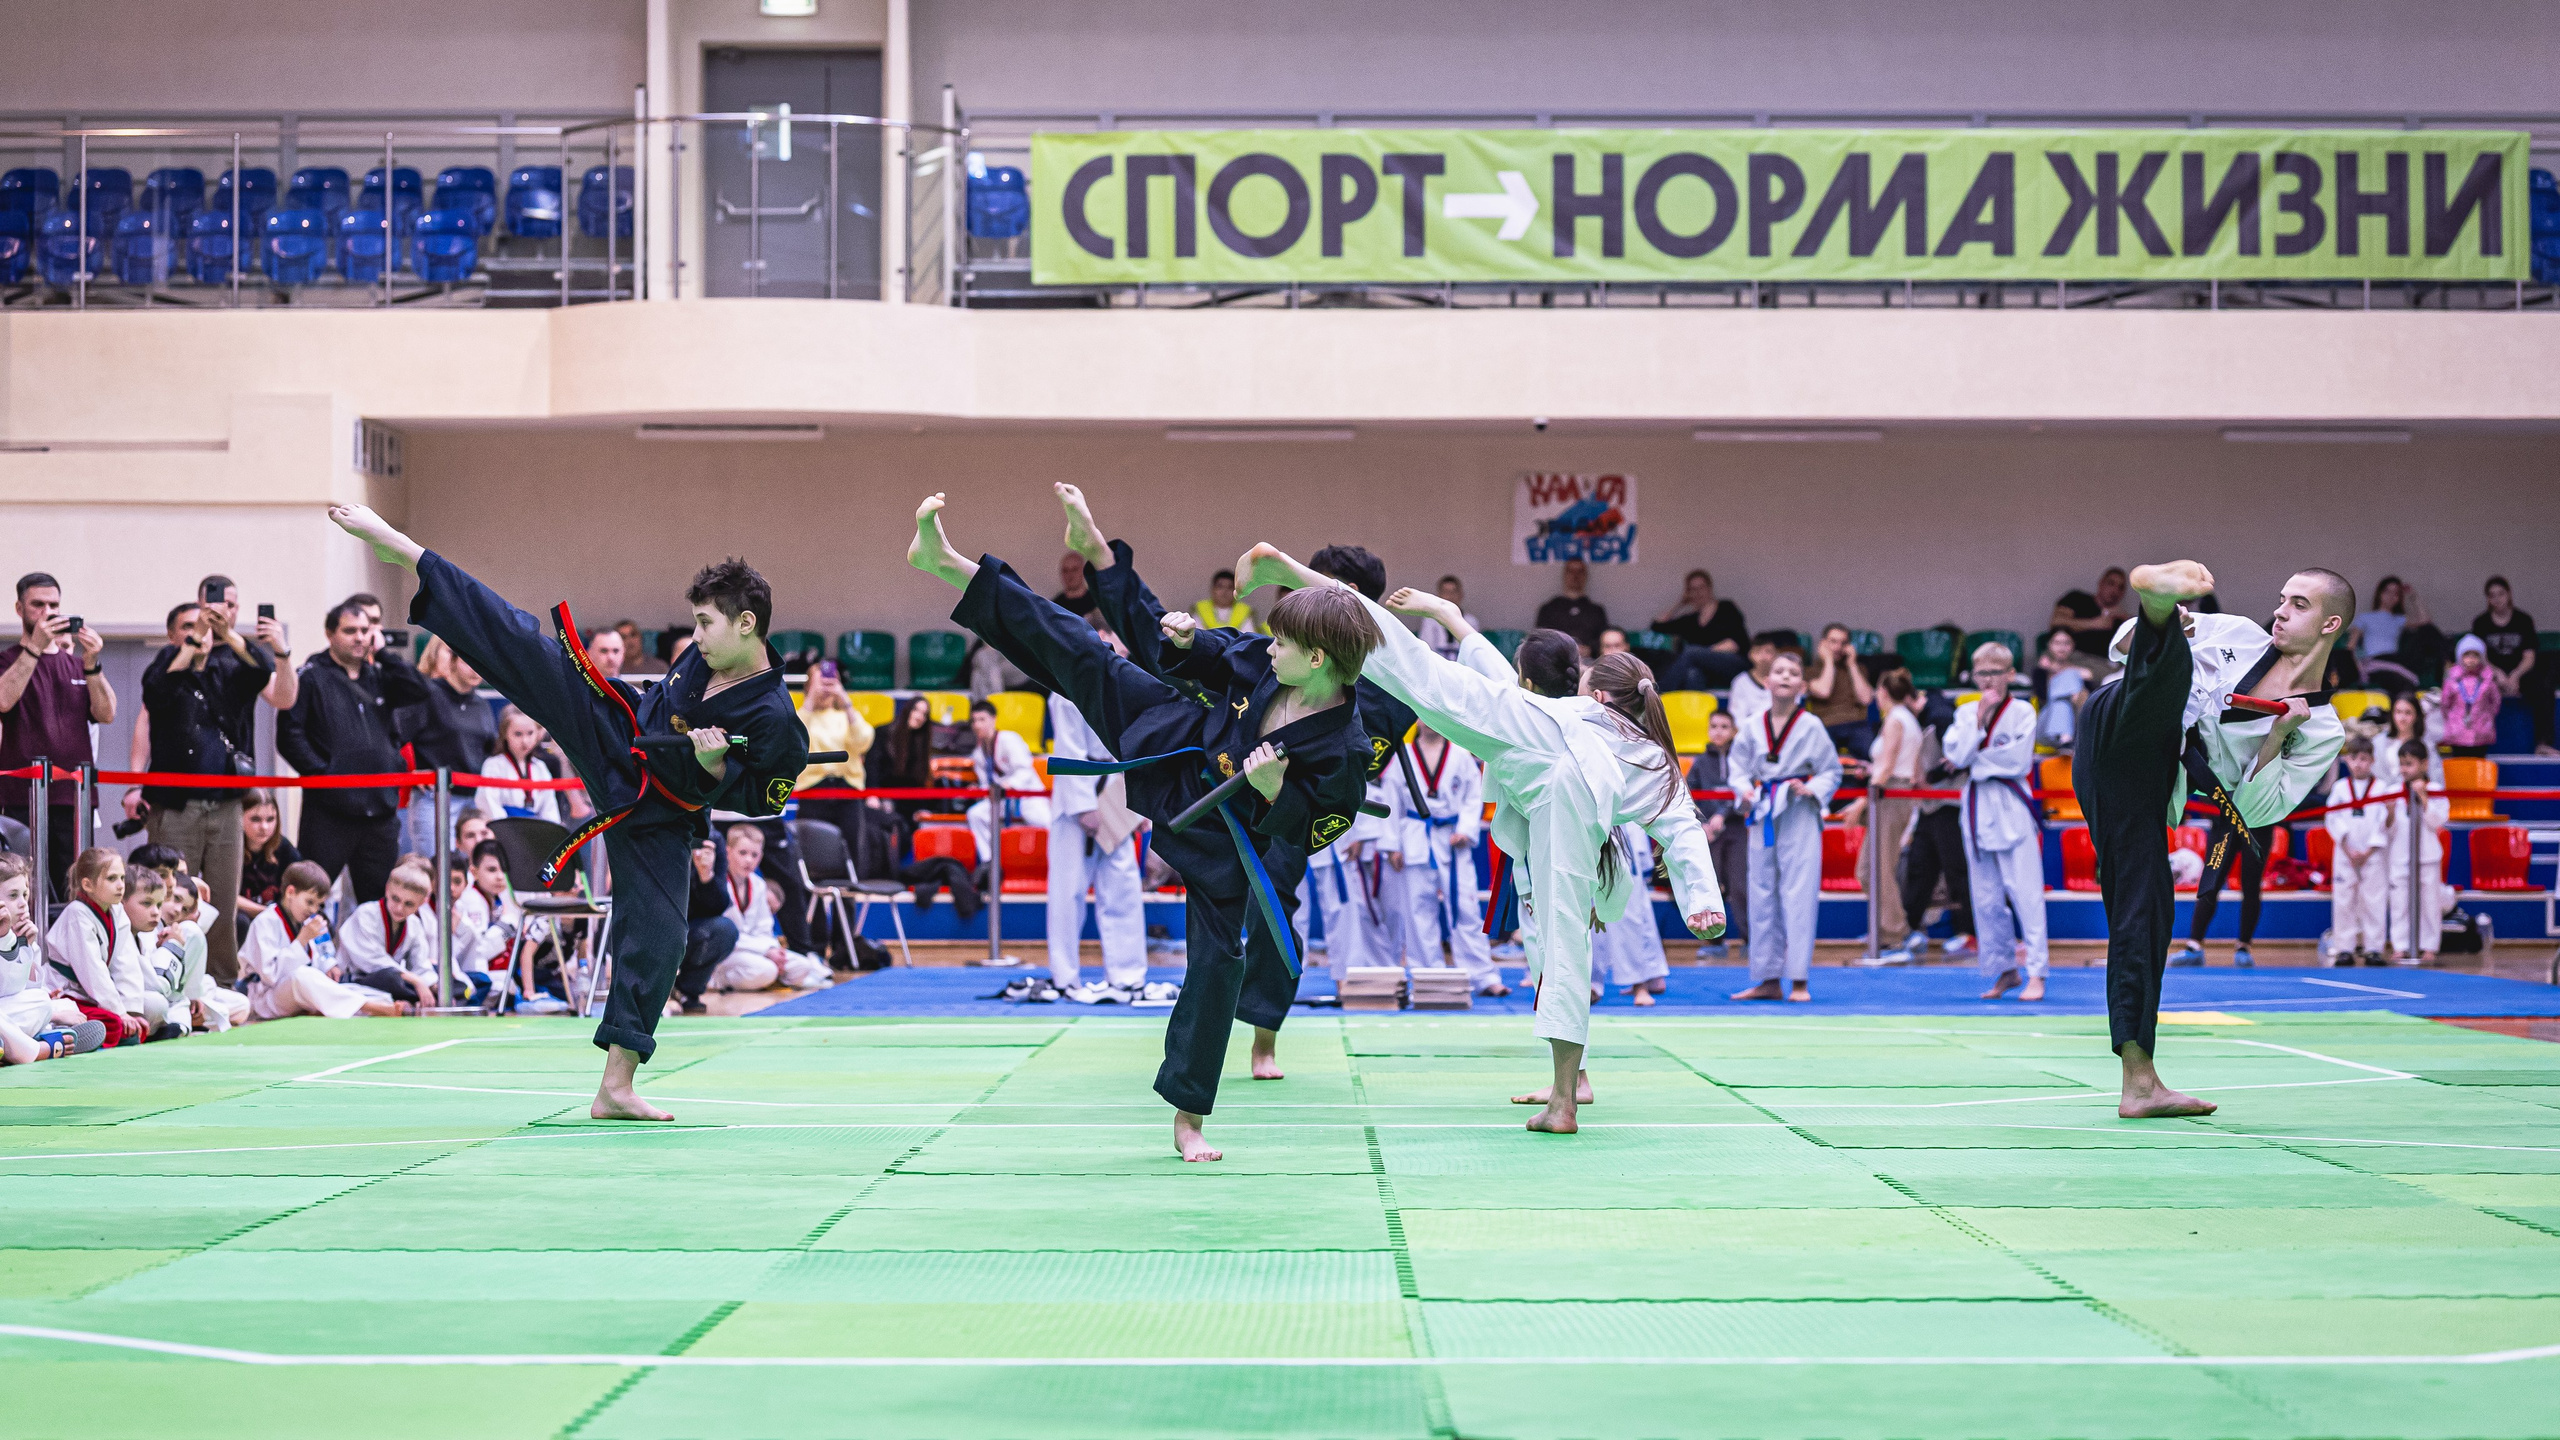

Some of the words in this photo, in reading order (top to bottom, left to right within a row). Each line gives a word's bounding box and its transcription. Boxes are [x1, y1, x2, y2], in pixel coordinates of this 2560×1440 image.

[1062, 152, 1446, 259] СПОРТ
[1552, 151, 2016, 258] НОРМА
[2041, 151, 2504, 257] ЖИЗНИ
[578, 648, 593, 670] Union
